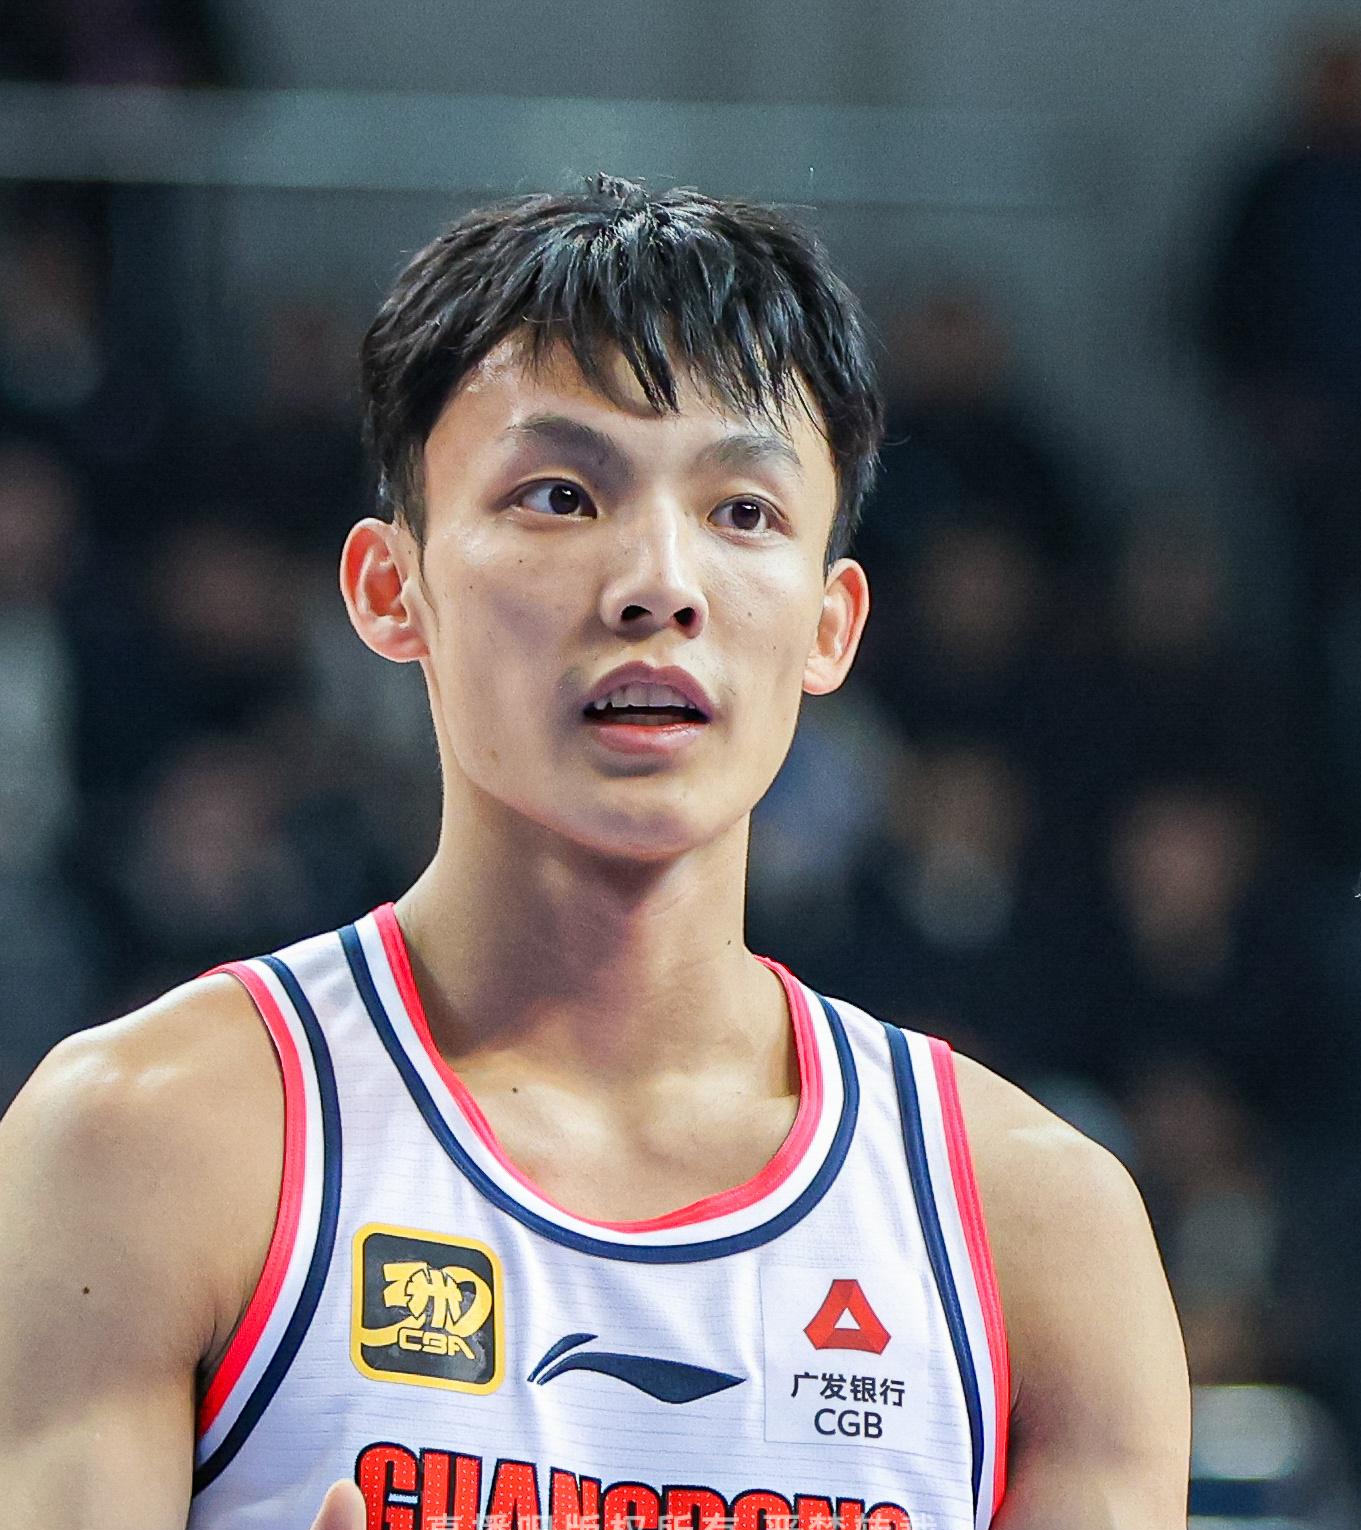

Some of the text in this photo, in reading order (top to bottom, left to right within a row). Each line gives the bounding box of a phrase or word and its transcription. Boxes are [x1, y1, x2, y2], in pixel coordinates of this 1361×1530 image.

[397, 1326, 476, 1361] CBA
[791, 1371, 905, 1407] 广发银行
[814, 1408, 883, 1439] CGB
